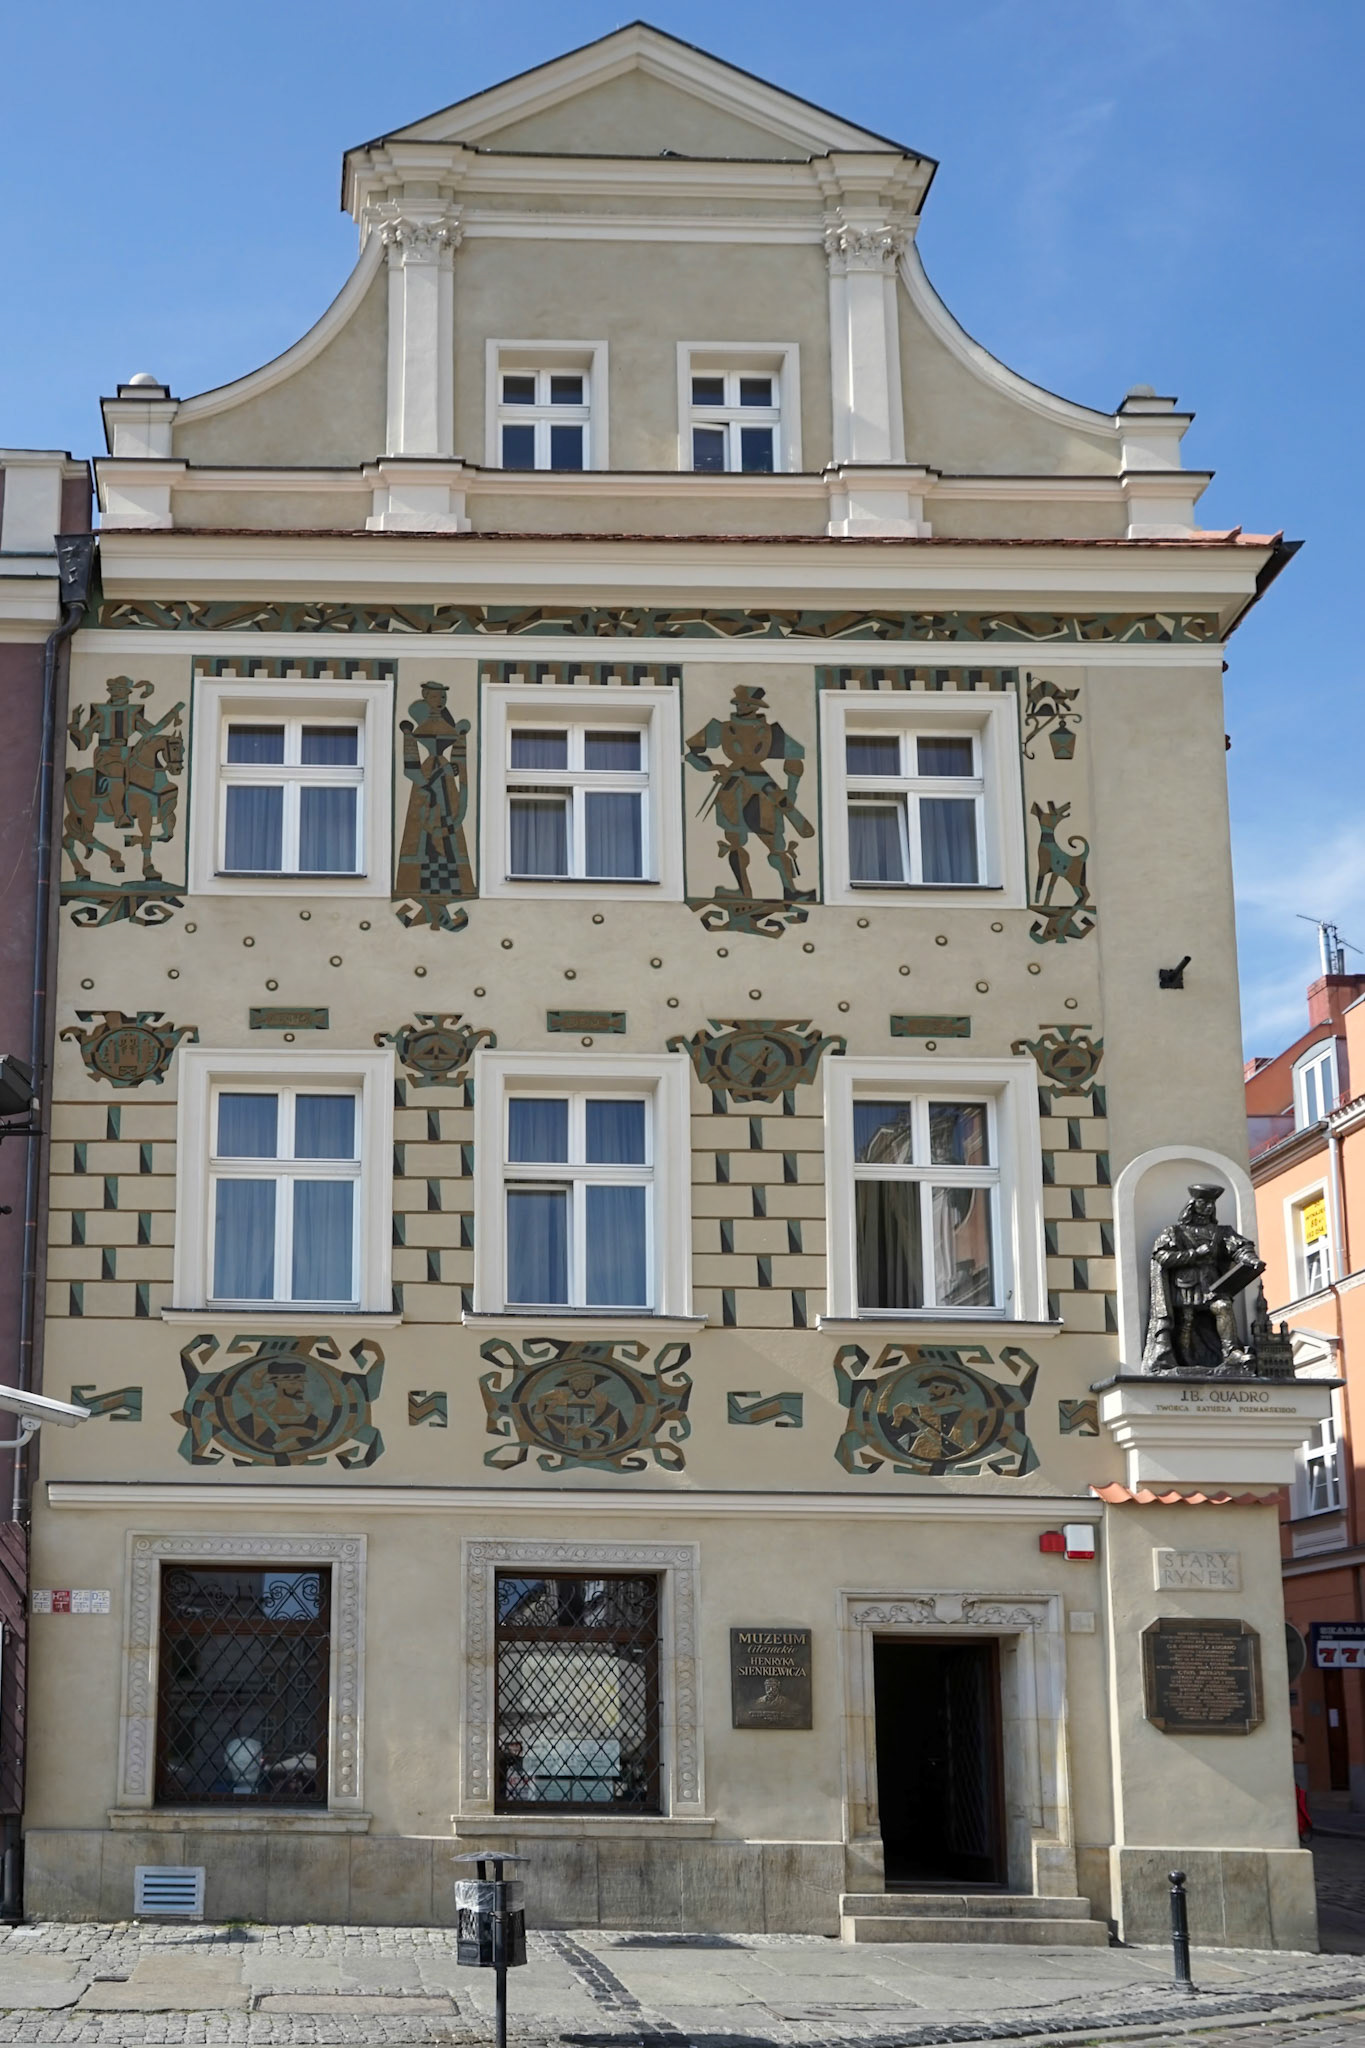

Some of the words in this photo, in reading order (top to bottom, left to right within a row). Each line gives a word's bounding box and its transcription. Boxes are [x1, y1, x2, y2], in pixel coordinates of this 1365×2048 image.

[1209, 1390, 1270, 1403] QUADRO
[1165, 1553, 1231, 1568] STARY
[1164, 1569, 1234, 1585] RYNEK
[739, 1633, 806, 1644] MUZEUM
[750, 1656, 795, 1666] HENRYKA
[739, 1666, 806, 1676] SIENKIEWICZA
